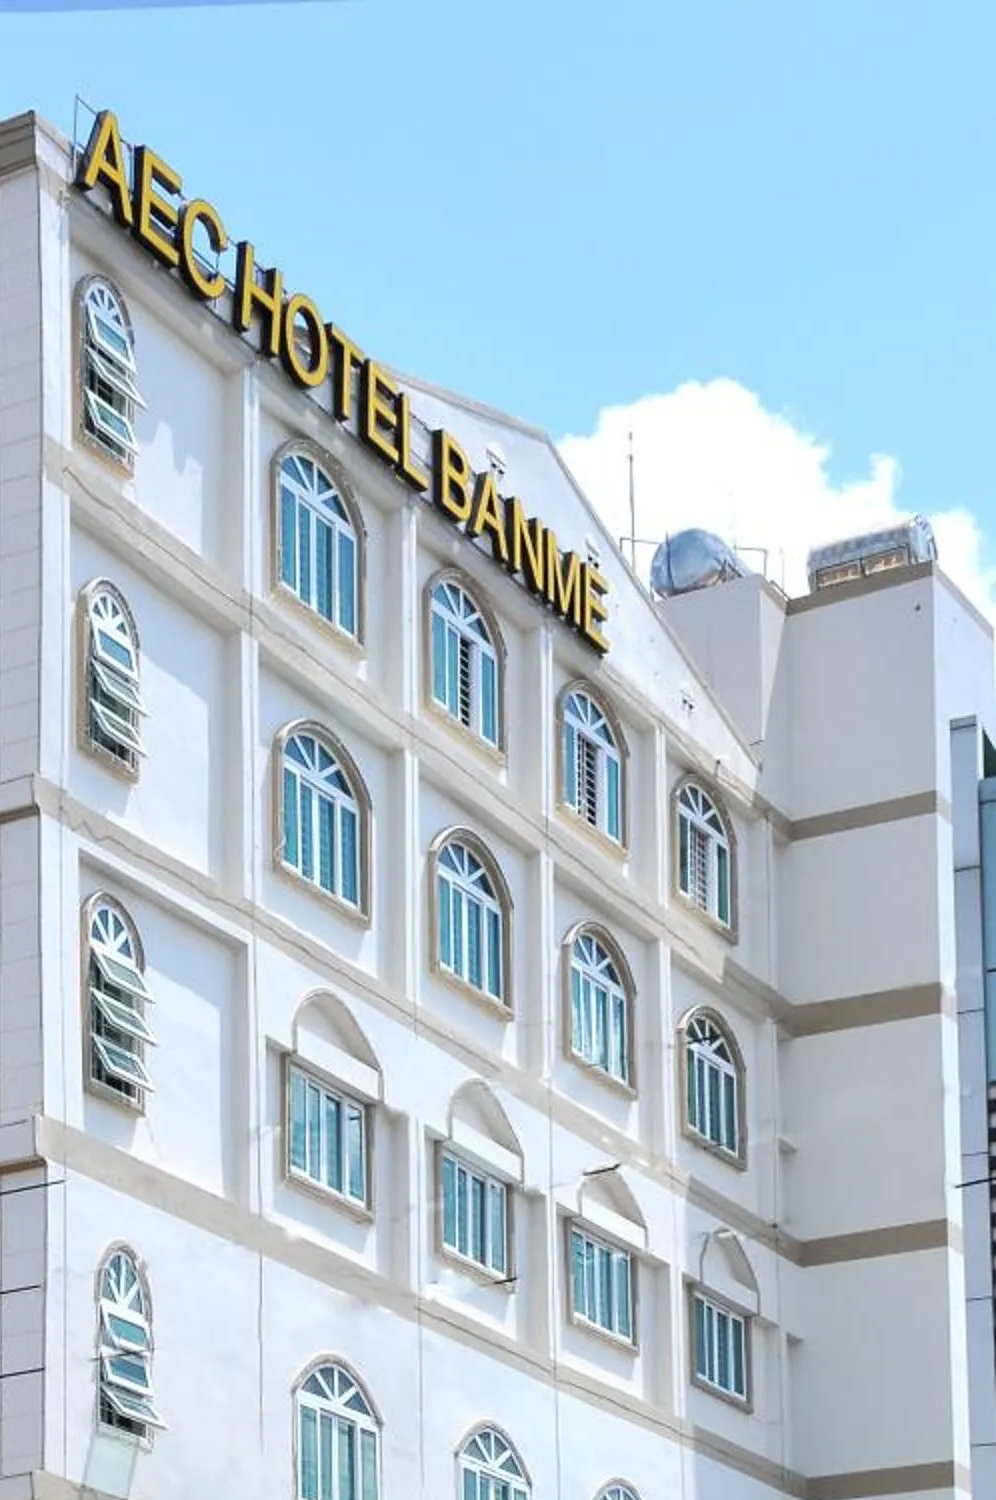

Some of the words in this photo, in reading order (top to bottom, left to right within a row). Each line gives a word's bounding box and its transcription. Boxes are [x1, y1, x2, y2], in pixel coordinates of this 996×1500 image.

[73, 109, 228, 299] AEC
[235, 240, 429, 493] HOTEL
[431, 428, 612, 654] BANME
